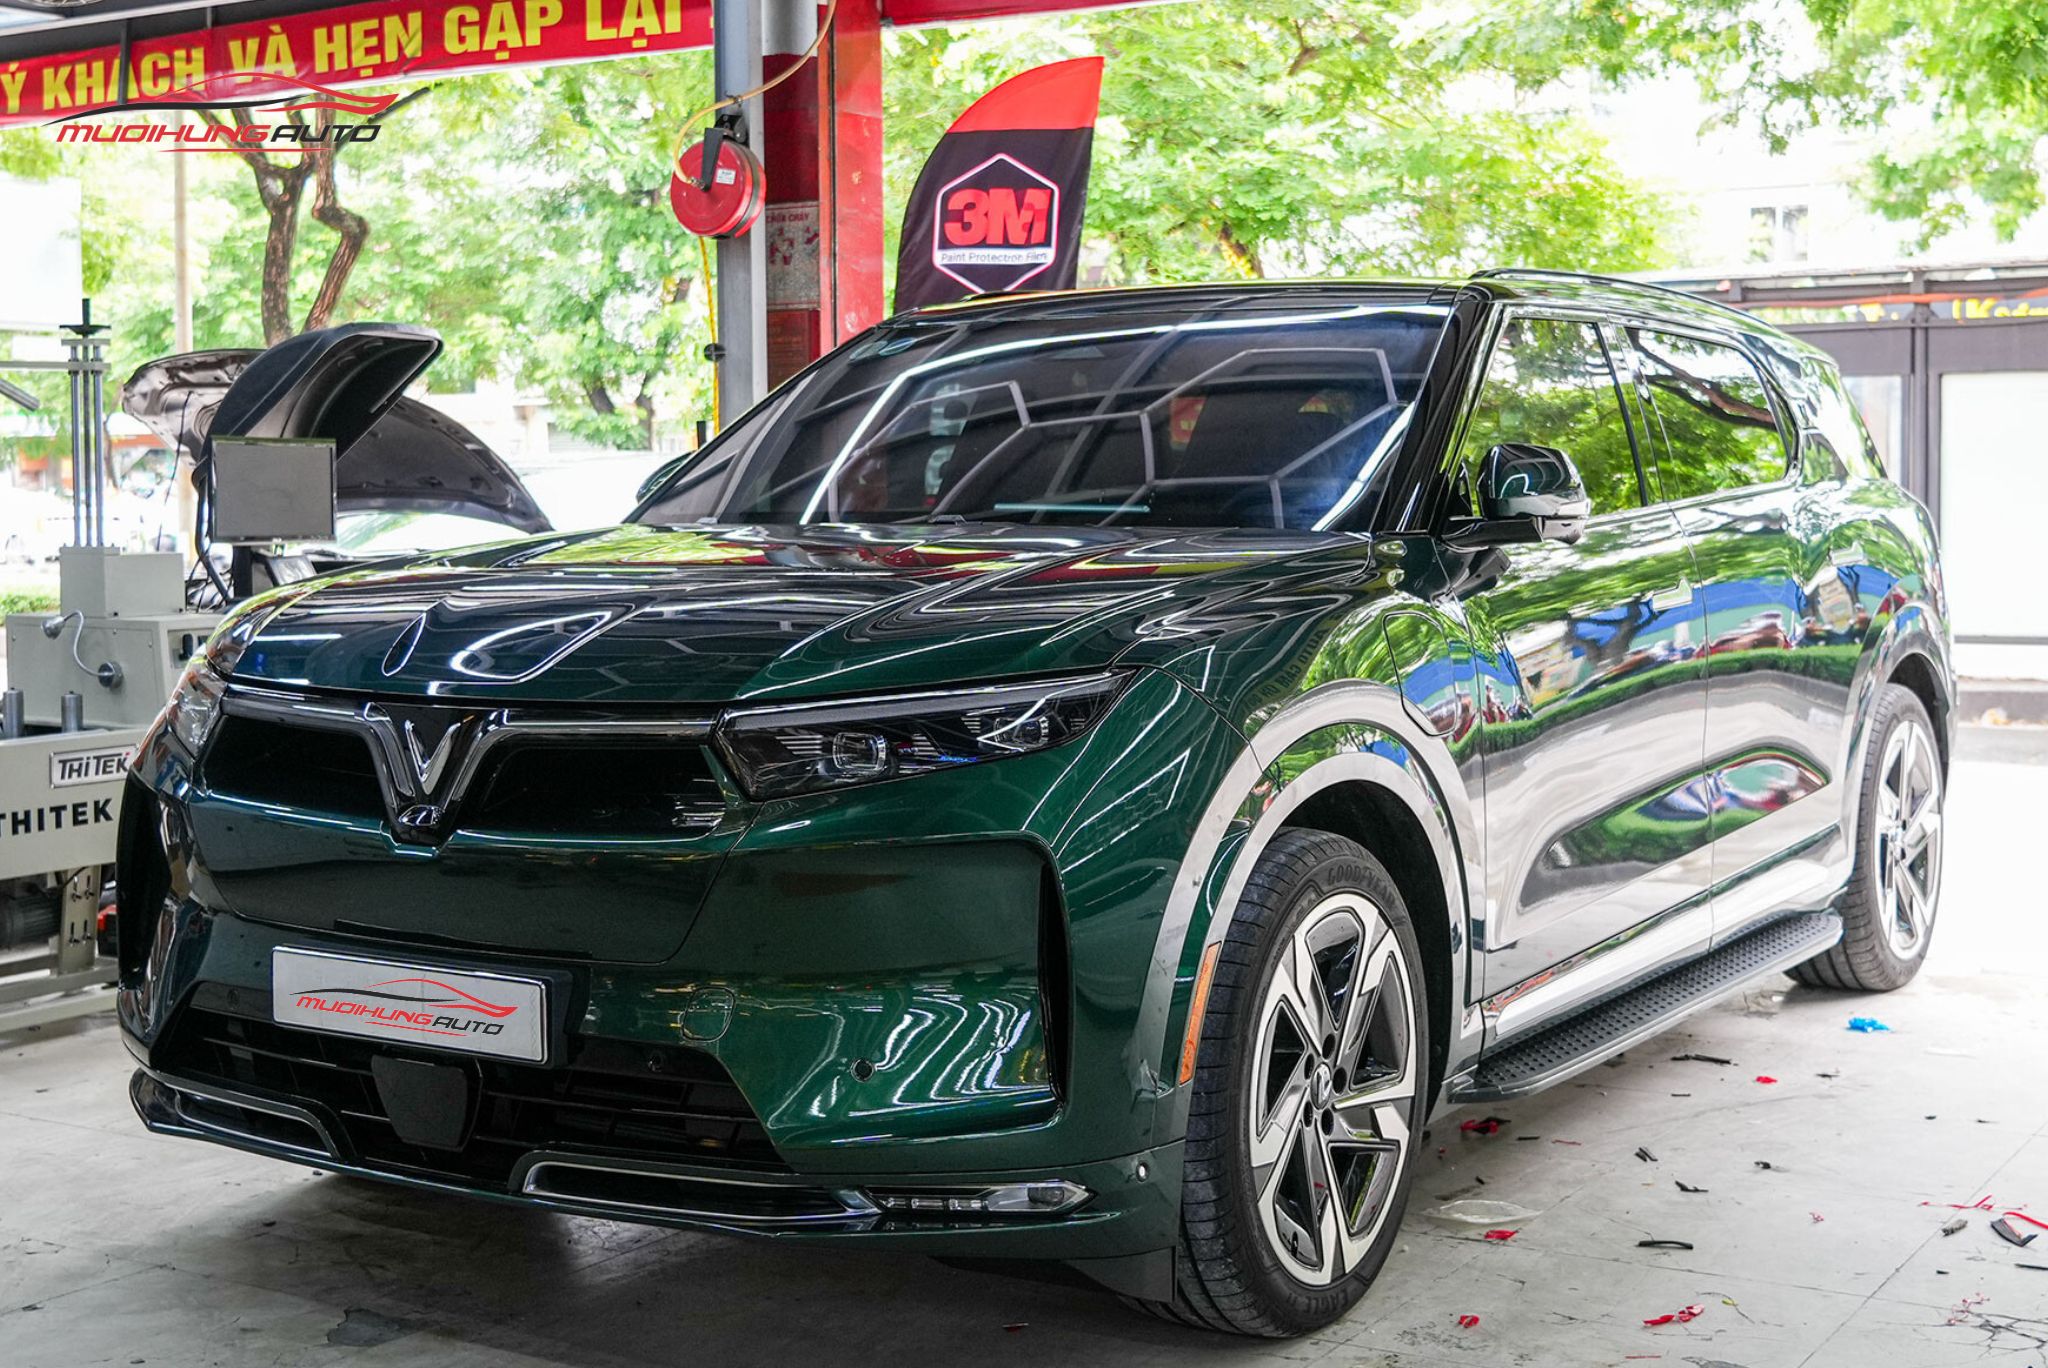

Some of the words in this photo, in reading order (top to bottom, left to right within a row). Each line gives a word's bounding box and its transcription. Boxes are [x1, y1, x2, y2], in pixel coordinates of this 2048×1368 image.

[228, 24, 298, 85] VÀ
[314, 11, 423, 78] HẸN
[943, 187, 1052, 247] 3M
[941, 252, 966, 263] Paint
[968, 252, 1024, 263] Protection
[1026, 251, 1048, 262] Film
